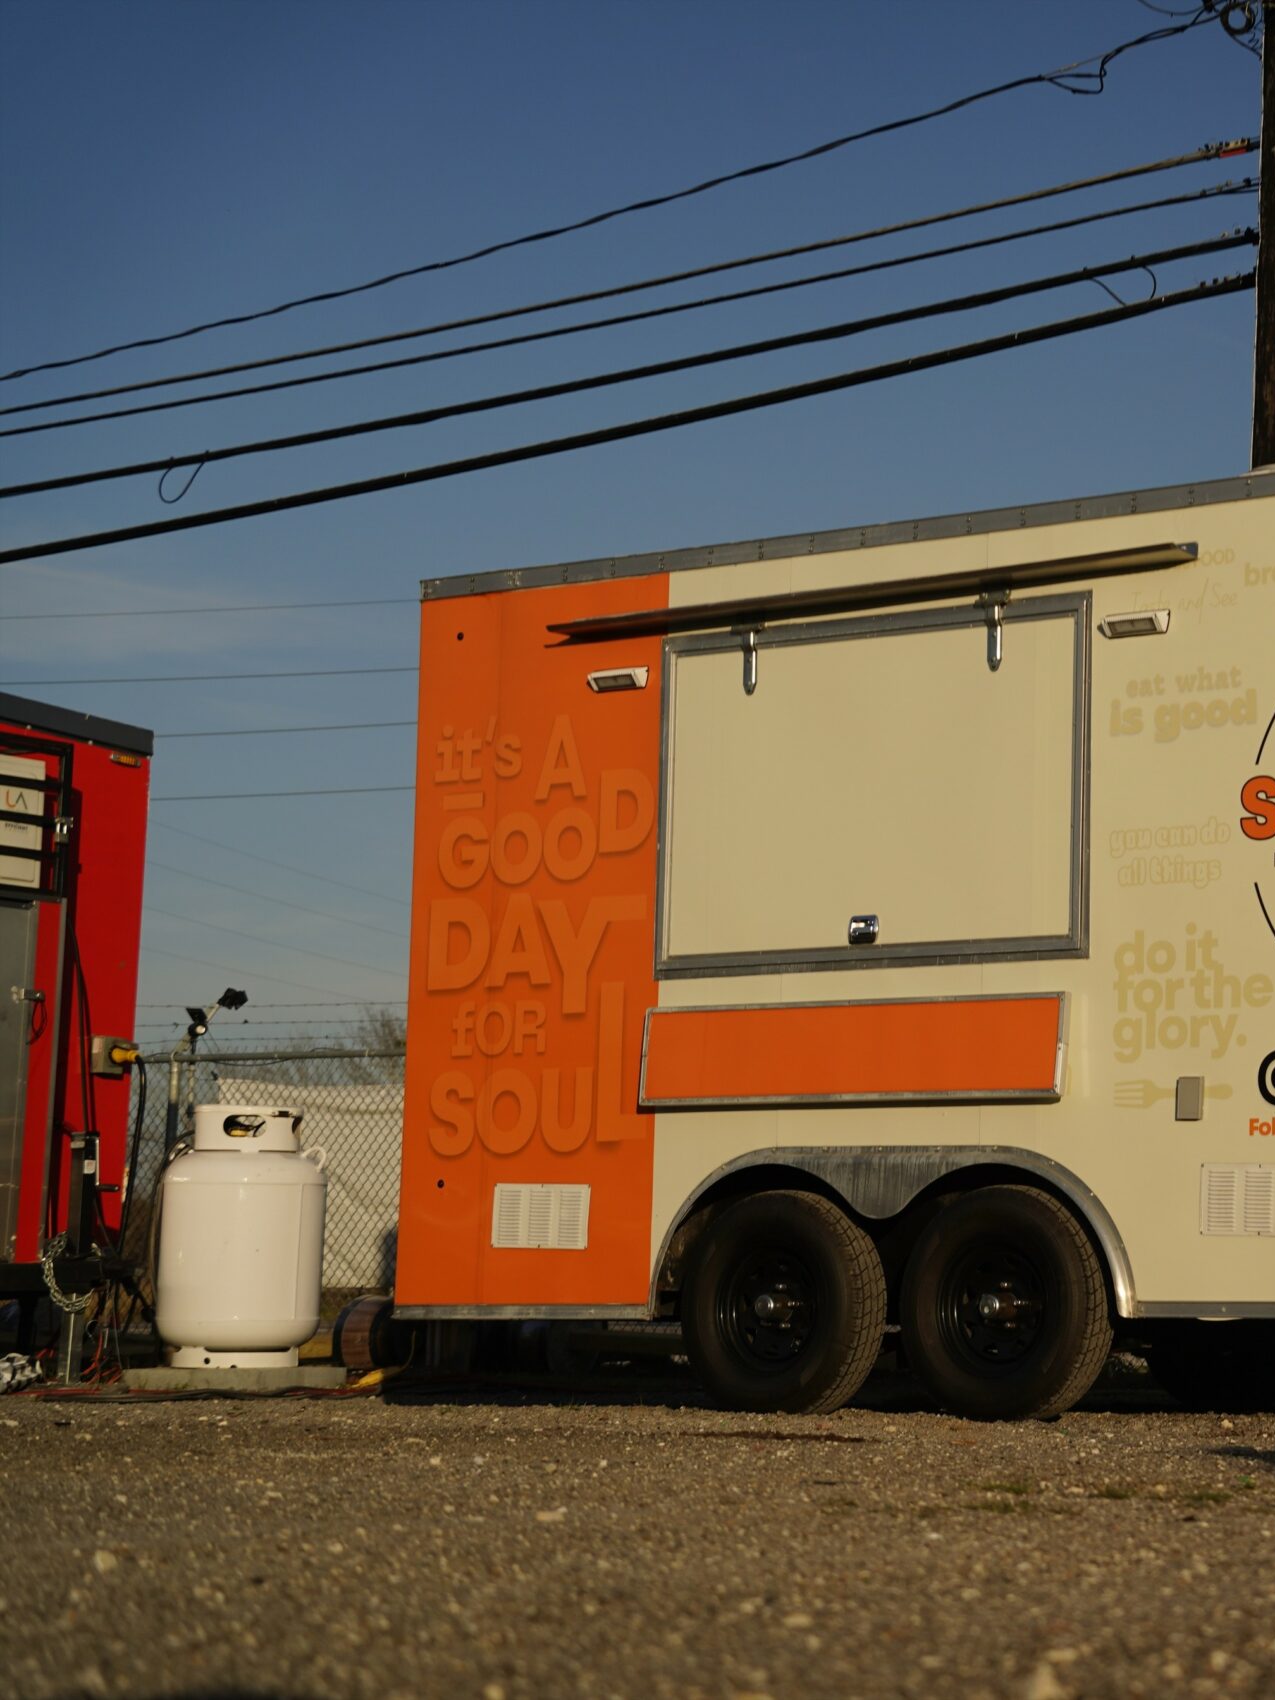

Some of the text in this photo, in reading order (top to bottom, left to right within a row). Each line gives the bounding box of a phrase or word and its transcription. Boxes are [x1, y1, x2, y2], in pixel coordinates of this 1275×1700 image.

[1125, 665, 1243, 699] eat what
[1109, 688, 1258, 744] is good
[434, 713, 588, 801] it's A
[438, 768, 656, 888] GOOD
[1109, 815, 1232, 860] you can do
[1117, 853, 1222, 890] all things
[427, 891, 648, 1014] DAY
[1113, 921, 1219, 975] do it
[1112, 963, 1274, 1013] for the
[1112, 1009, 1248, 1064] glory.
[428, 981, 648, 1156] SOUL
